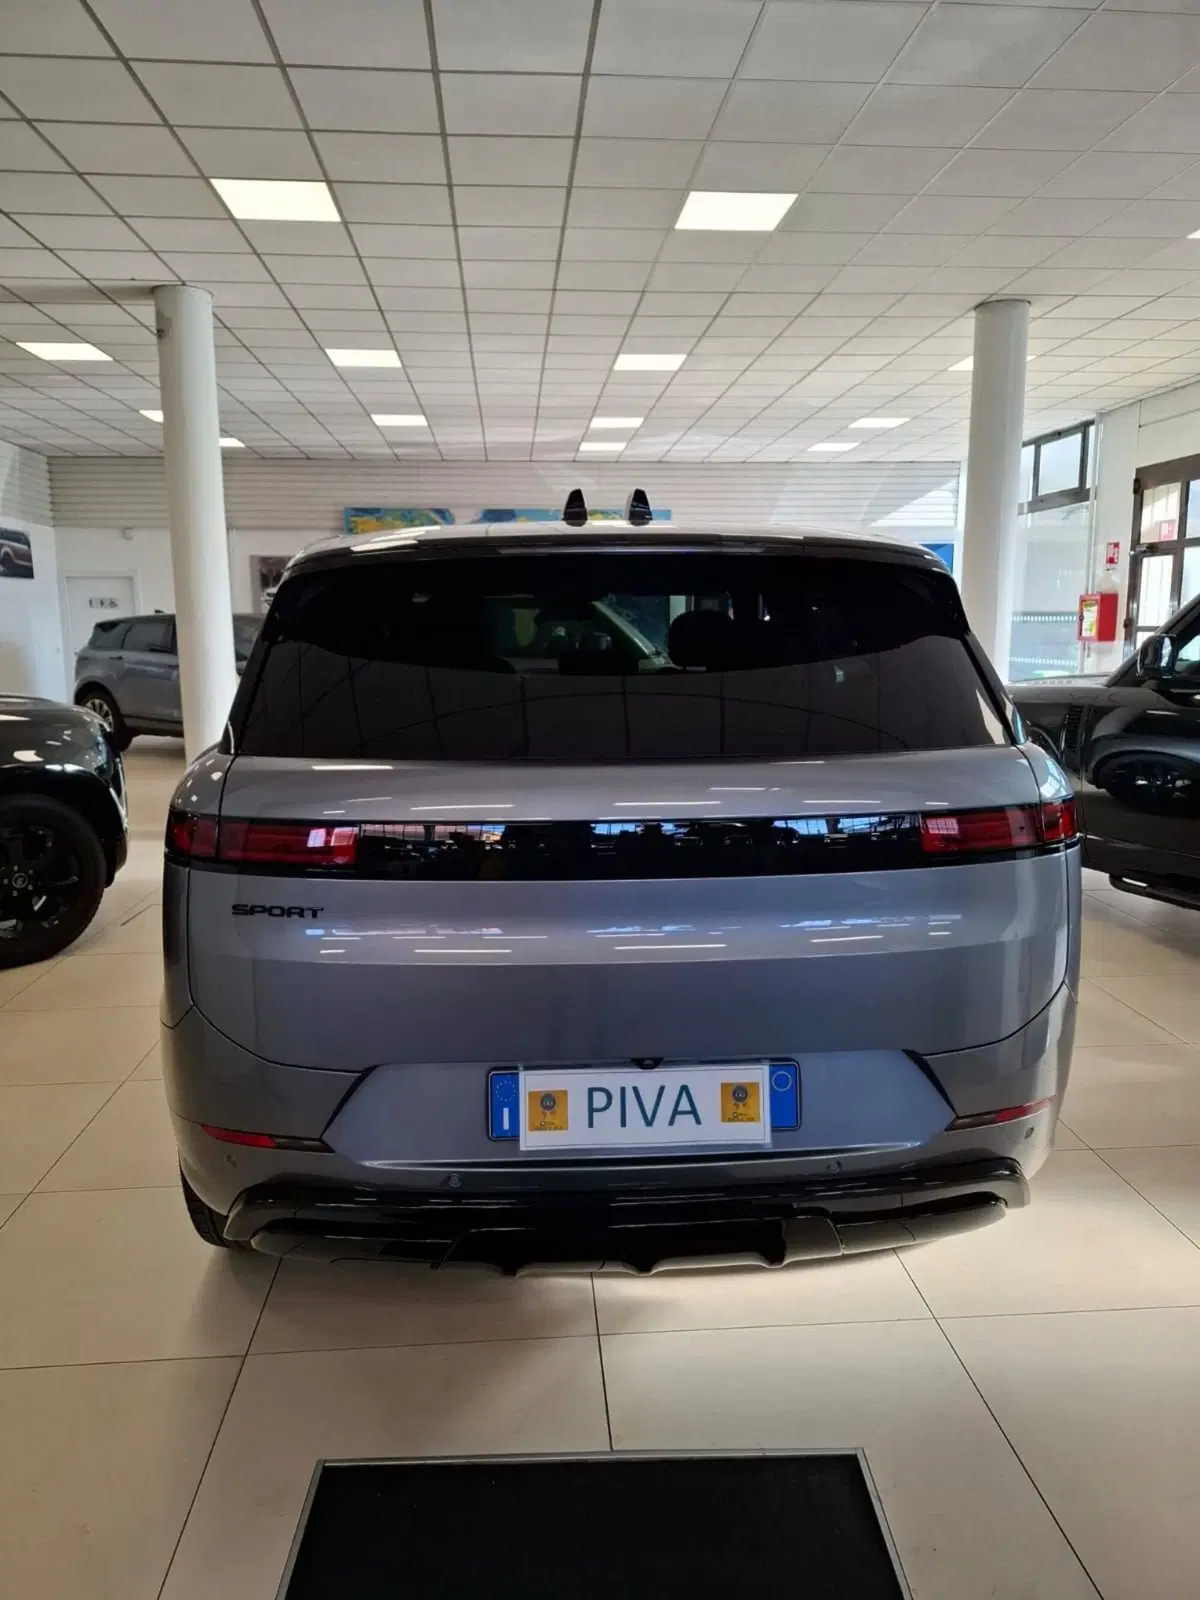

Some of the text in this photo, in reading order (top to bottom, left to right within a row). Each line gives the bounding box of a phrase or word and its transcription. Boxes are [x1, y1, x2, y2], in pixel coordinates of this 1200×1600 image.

[232, 903, 324, 919] SPORT
[587, 1084, 702, 1128] PIVA
[502, 1107, 510, 1130] I
